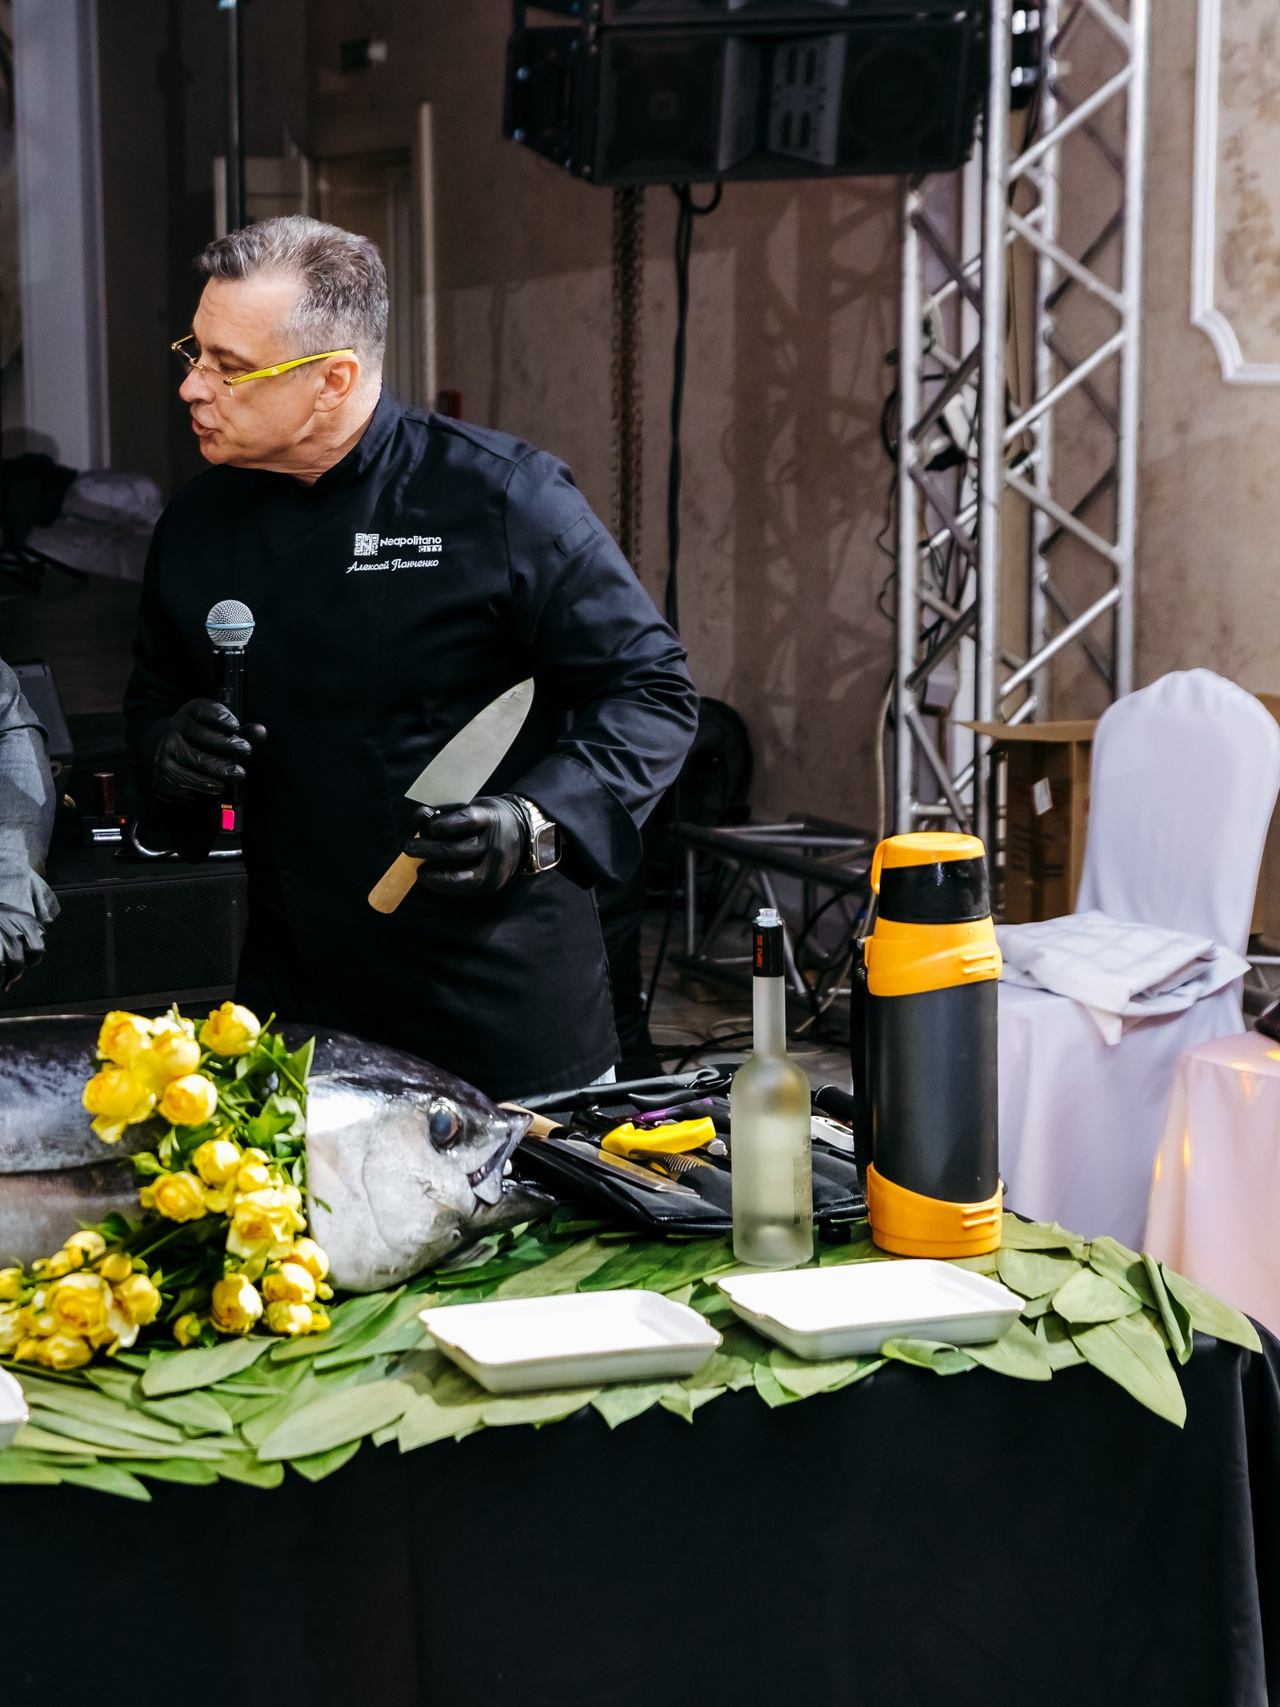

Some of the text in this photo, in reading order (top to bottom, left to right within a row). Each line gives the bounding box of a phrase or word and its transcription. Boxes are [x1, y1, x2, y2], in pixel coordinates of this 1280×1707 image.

[380, 536, 442, 547] Neapolitano
[346, 559, 439, 573] Алексей Панченко
